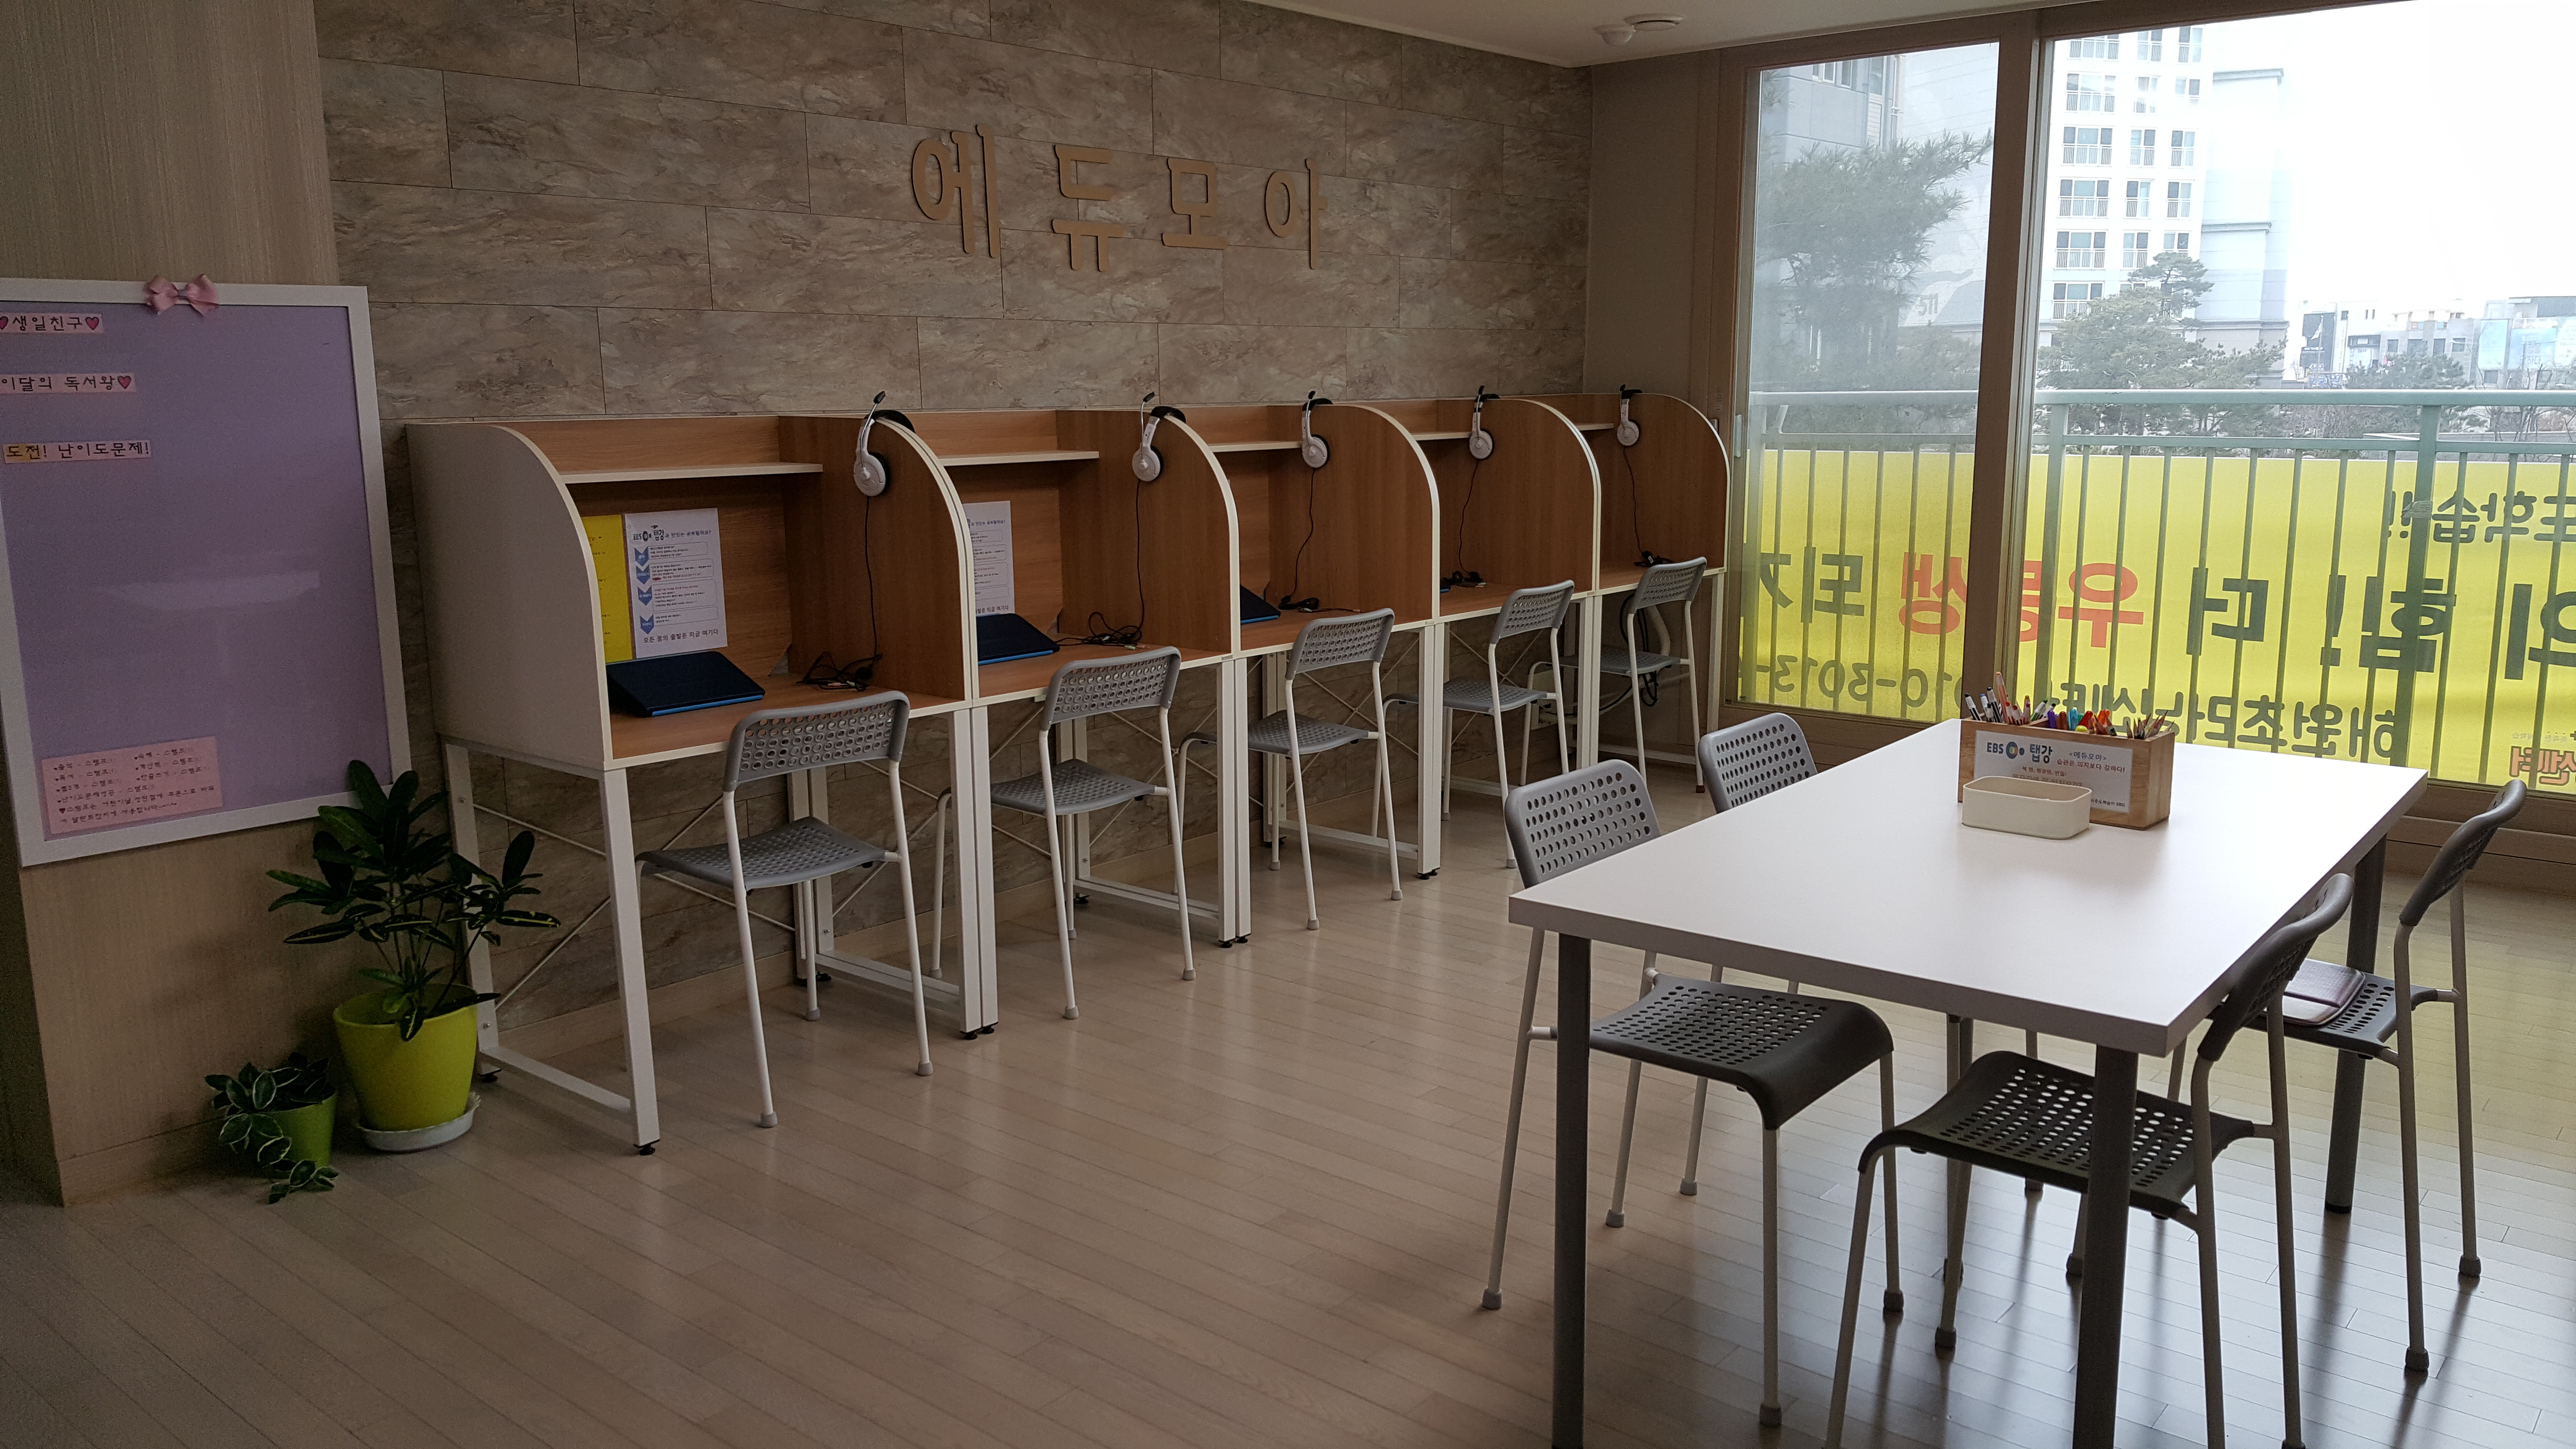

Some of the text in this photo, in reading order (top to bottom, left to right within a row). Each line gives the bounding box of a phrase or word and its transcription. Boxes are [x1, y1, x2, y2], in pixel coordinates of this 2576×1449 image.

[912, 125, 1327, 272] 에듀모아
[12, 315, 82, 331] 생일친구
[1, 375, 115, 391] 이달의 독서왕
[6, 441, 150, 459] 도전! 난이도문제!
[1986, 741, 2053, 764] EBS 탭강
[2056, 758, 2125, 773] 습관은 의지보다 강하다!
